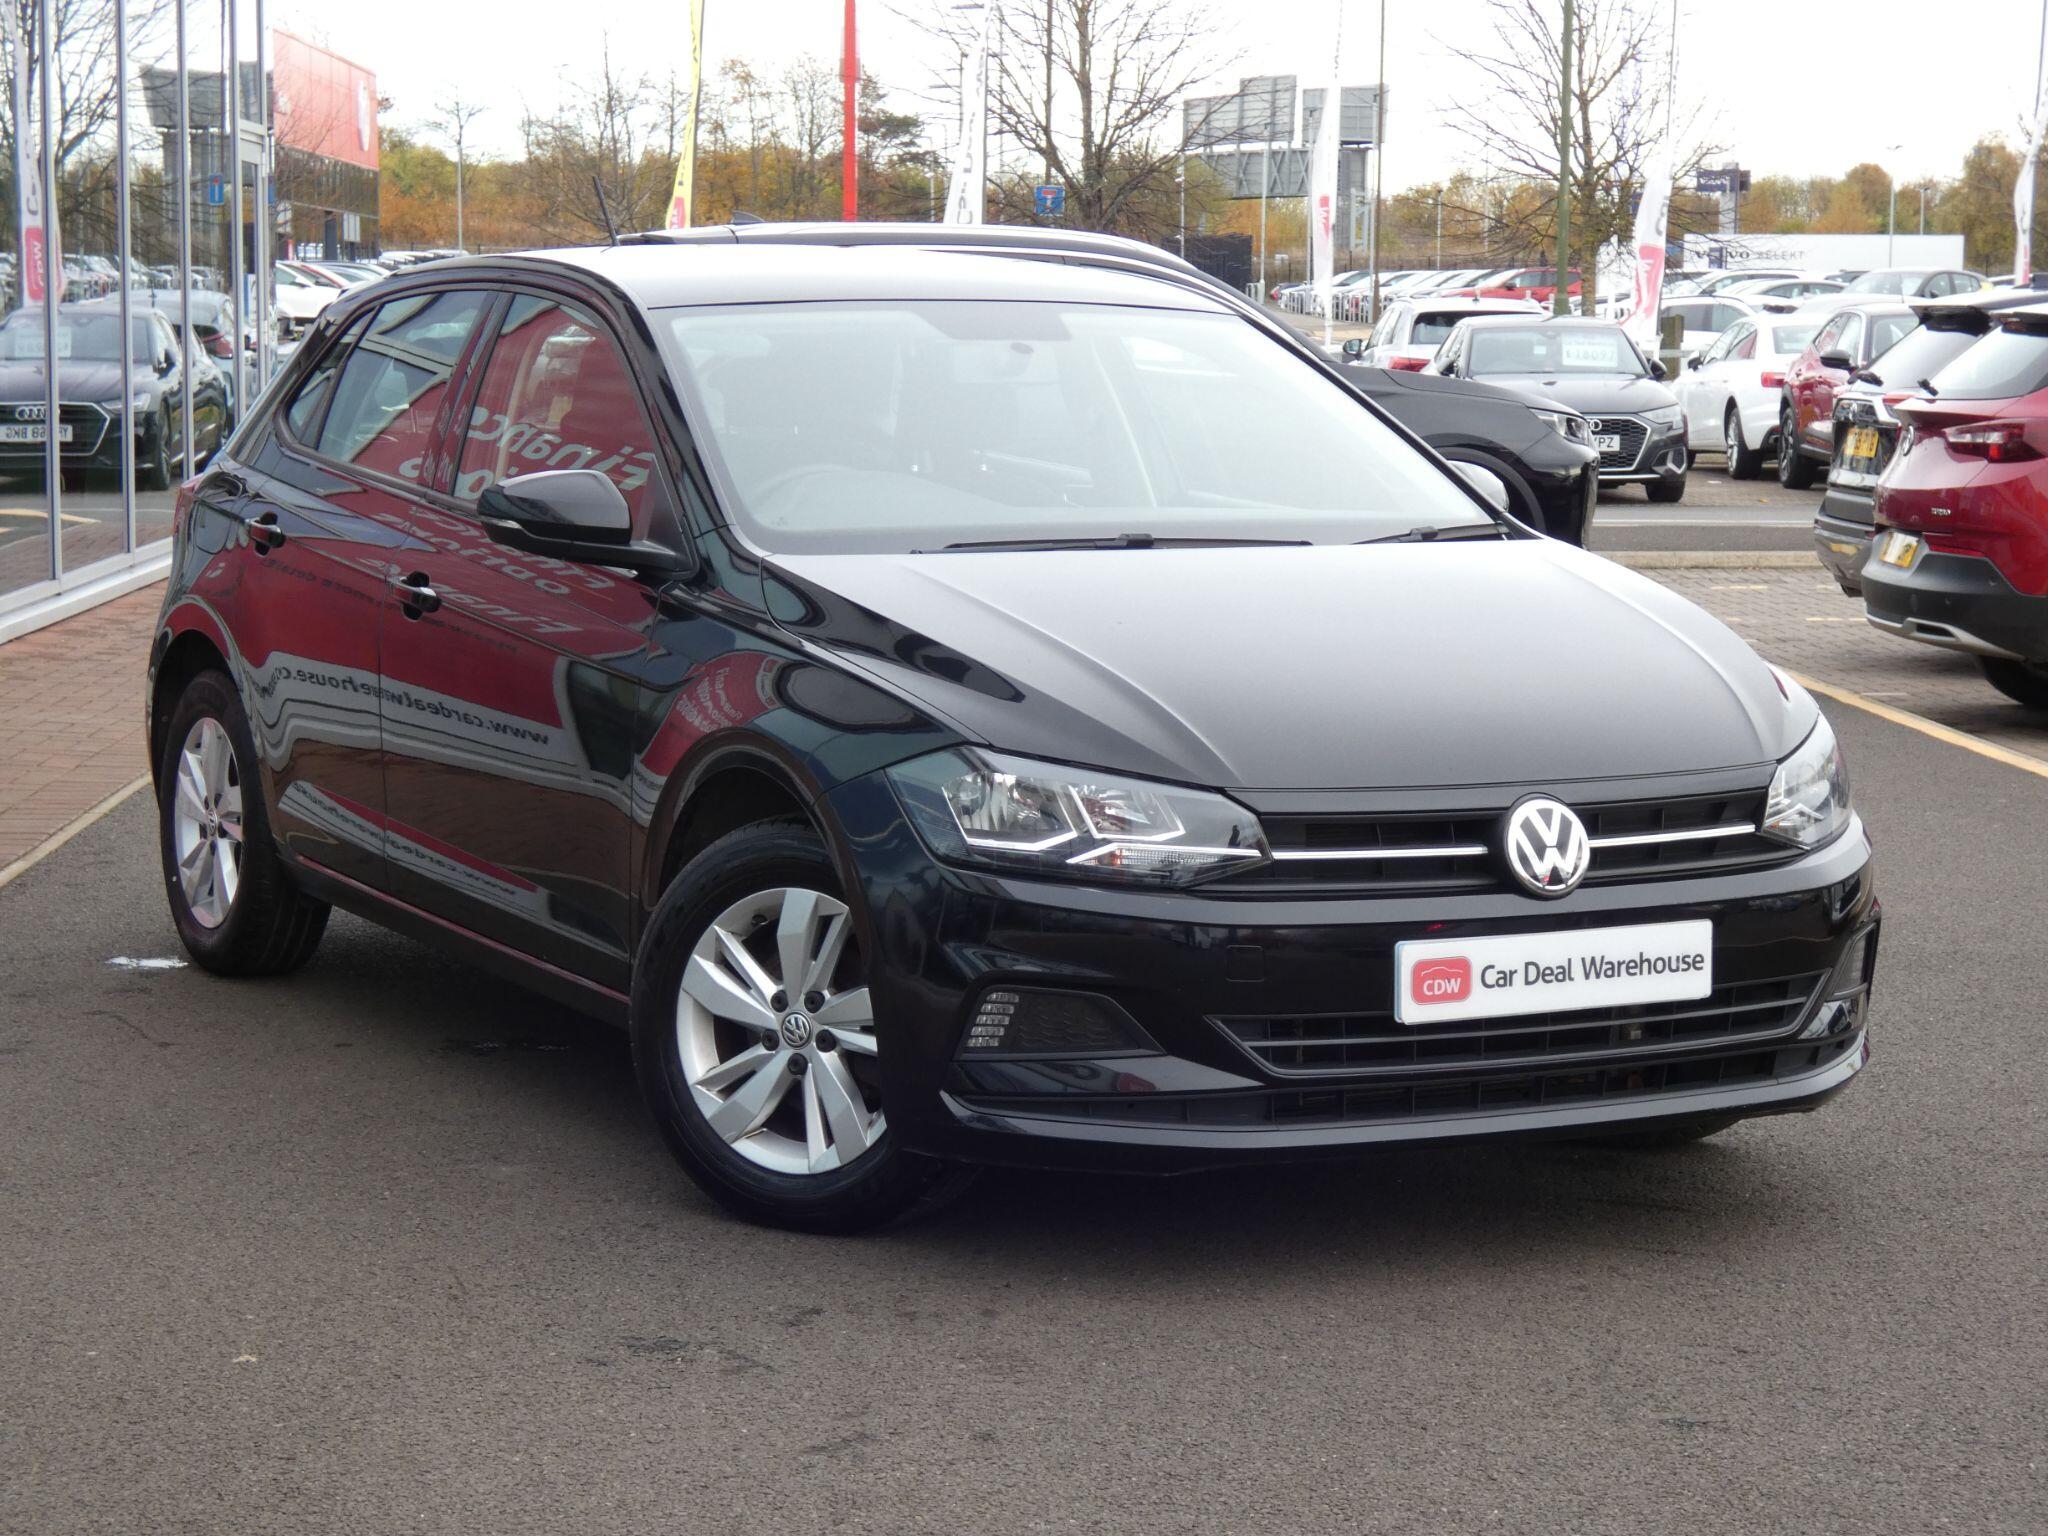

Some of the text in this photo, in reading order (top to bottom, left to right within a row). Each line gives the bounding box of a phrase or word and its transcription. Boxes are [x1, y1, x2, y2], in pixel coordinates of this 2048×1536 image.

[1508, 799, 1591, 895] VW
[1422, 950, 1705, 998] CDW Car Deal Warehouse
[782, 1012, 812, 1048] VW
